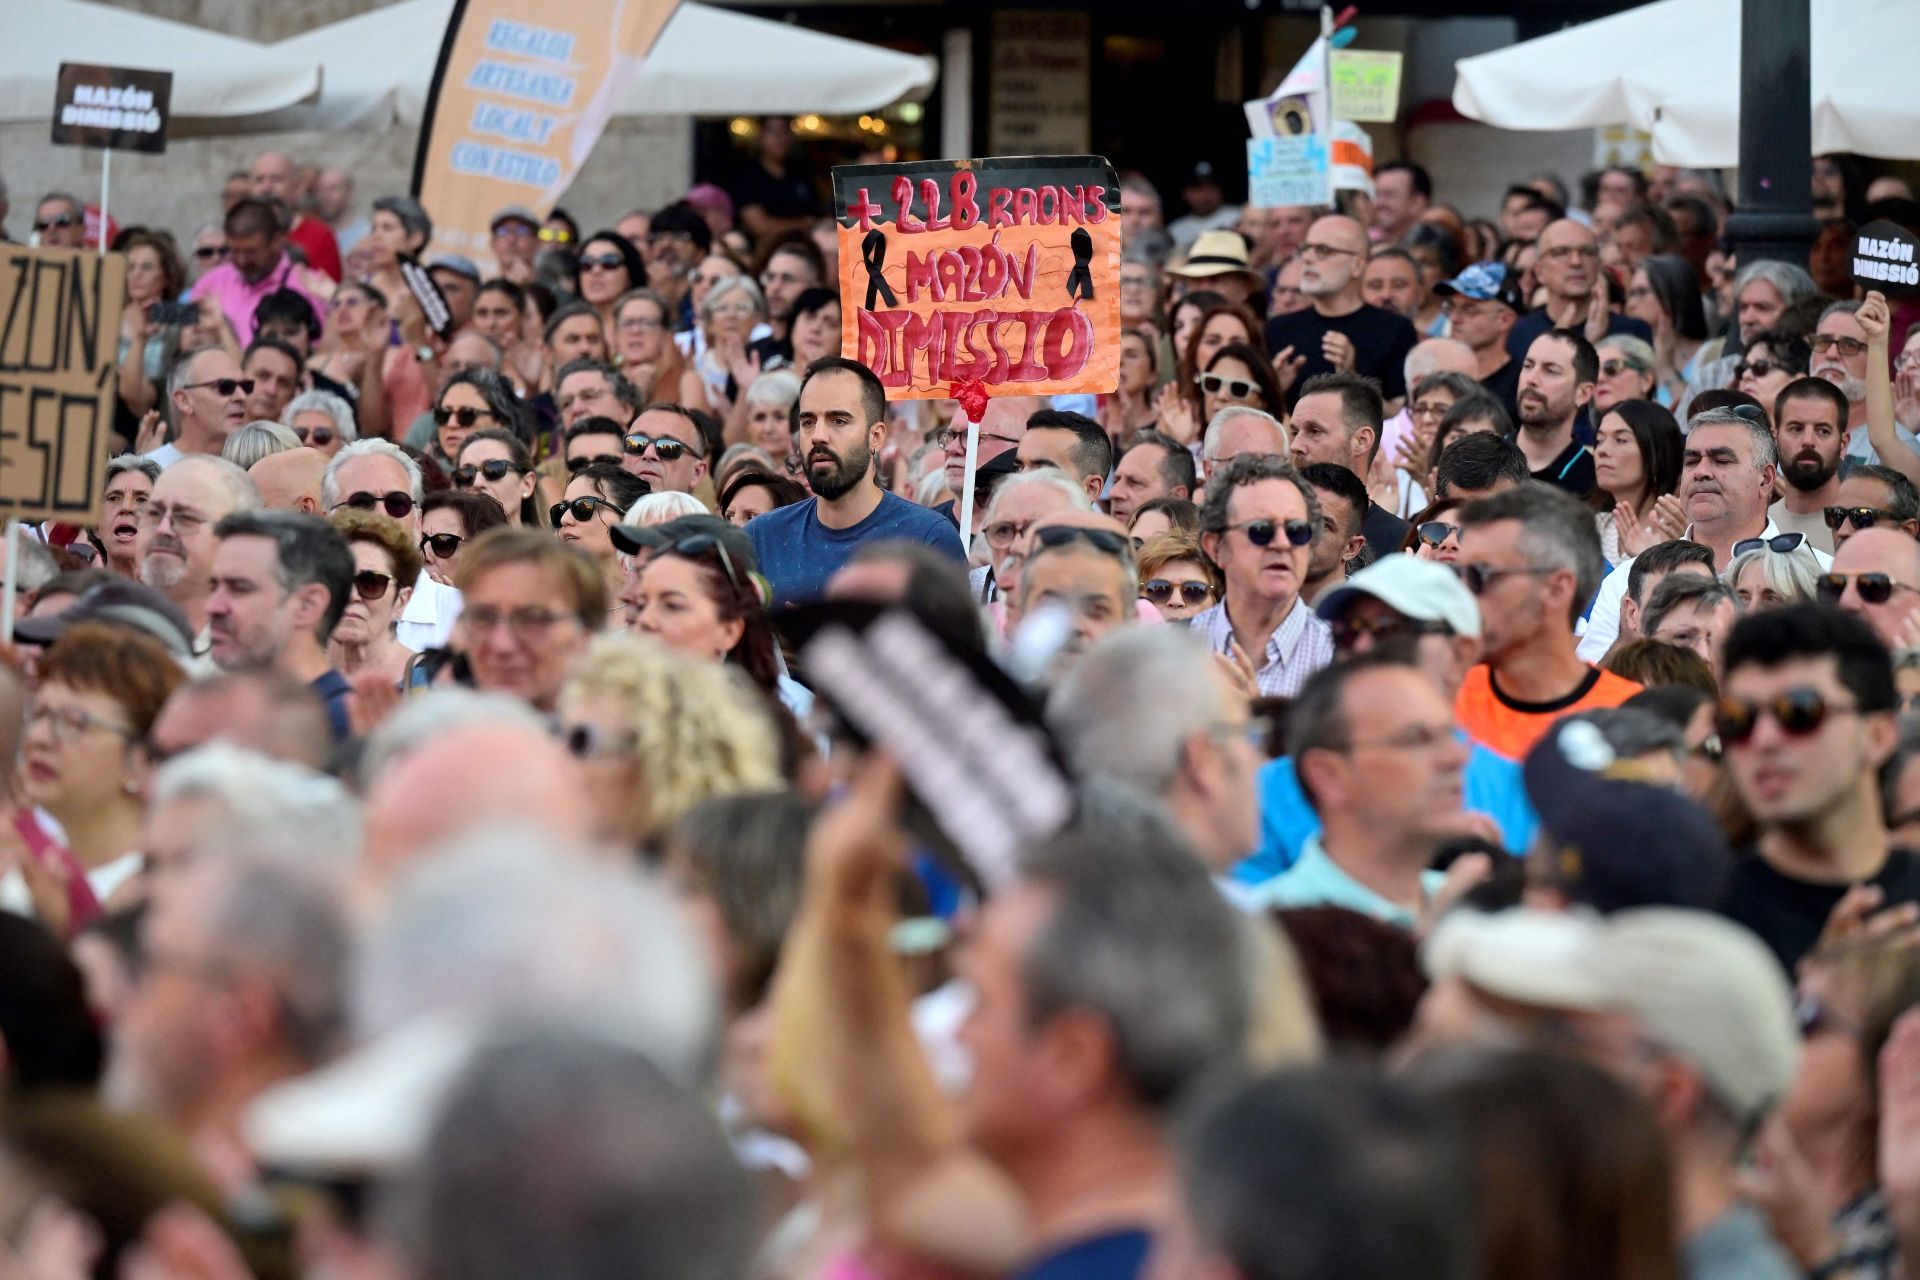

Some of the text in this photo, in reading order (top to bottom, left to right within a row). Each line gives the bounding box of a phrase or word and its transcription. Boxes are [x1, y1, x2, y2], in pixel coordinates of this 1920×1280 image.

[892, 170, 980, 234] 228
[988, 185, 1107, 229] RAONS
[906, 229, 1037, 303] MAZÓN
[1853, 257, 1919, 286] DIMISSIÓ
[1859, 236, 1914, 262] MAZÓN
